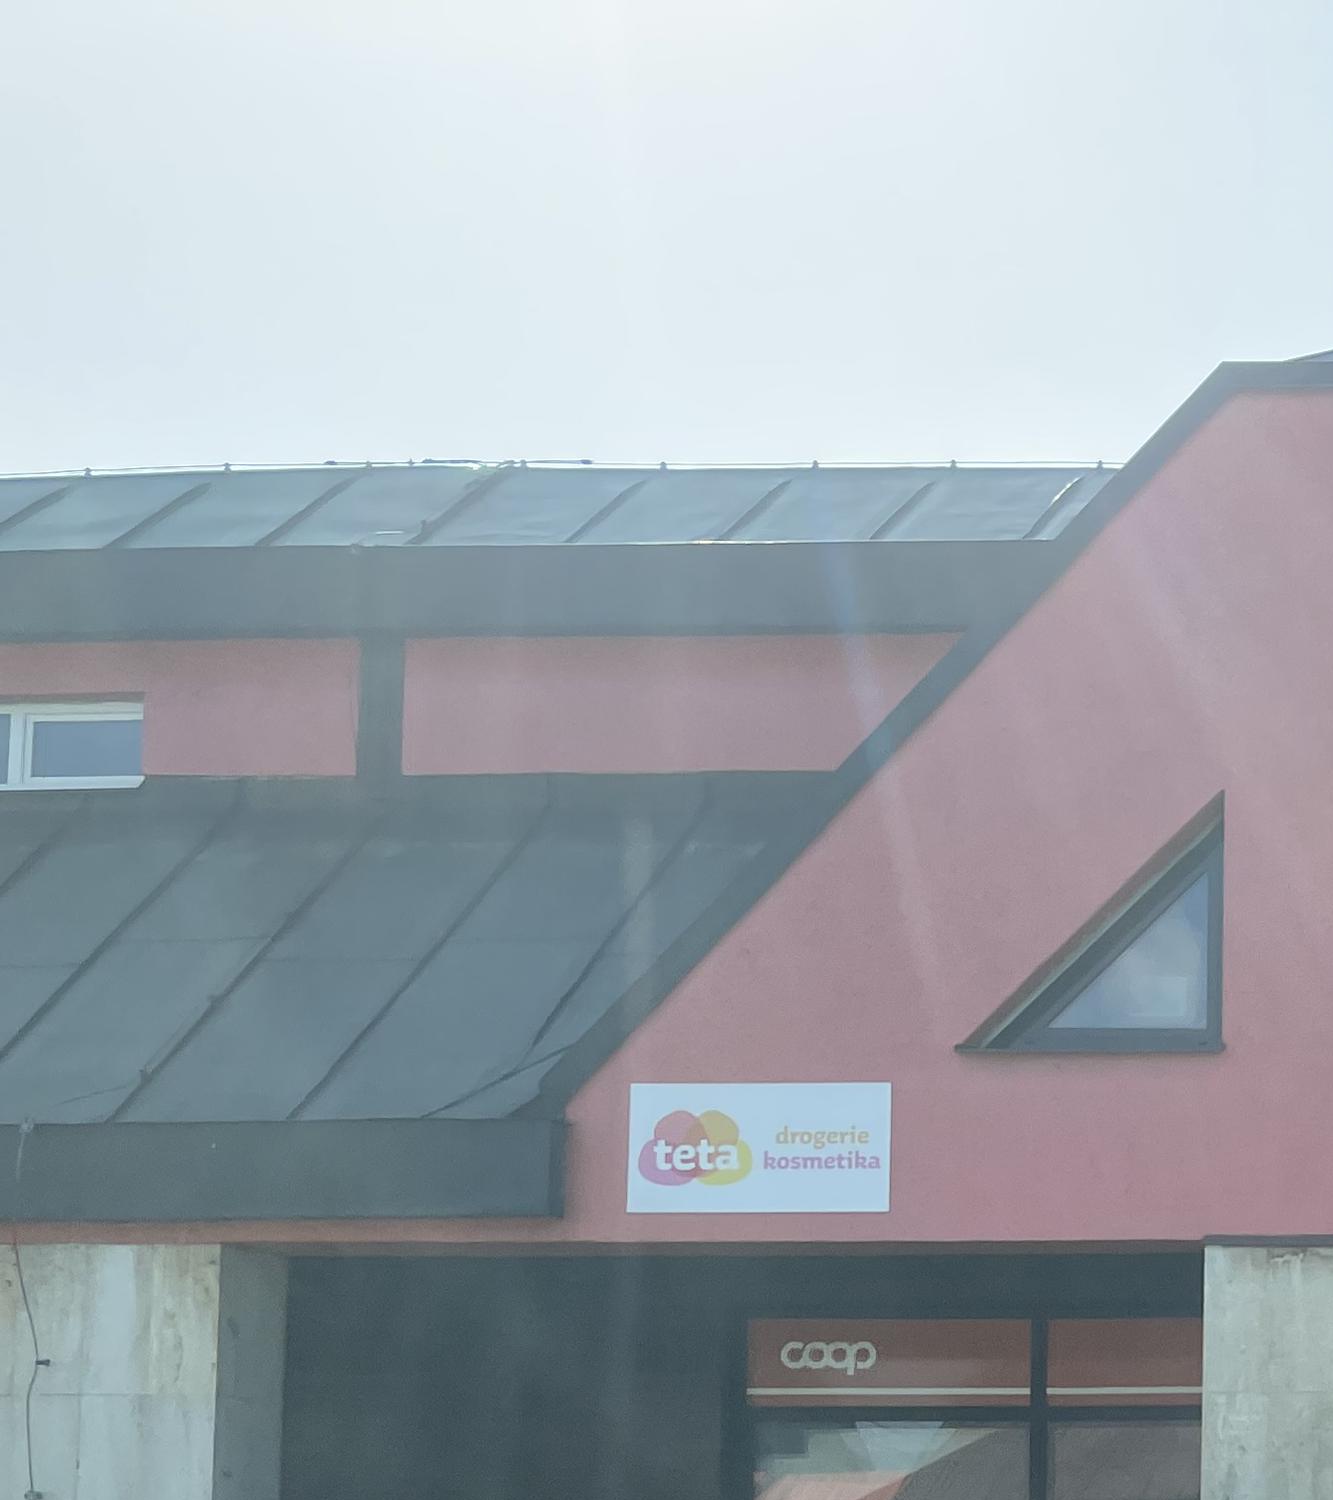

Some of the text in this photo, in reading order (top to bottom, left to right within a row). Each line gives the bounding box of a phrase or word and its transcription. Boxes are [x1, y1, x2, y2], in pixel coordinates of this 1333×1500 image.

[775, 1126, 869, 1149] drogerie
[653, 1139, 740, 1171] teta
[763, 1151, 881, 1170] kosmetika
[780, 1341, 877, 1375] coop
